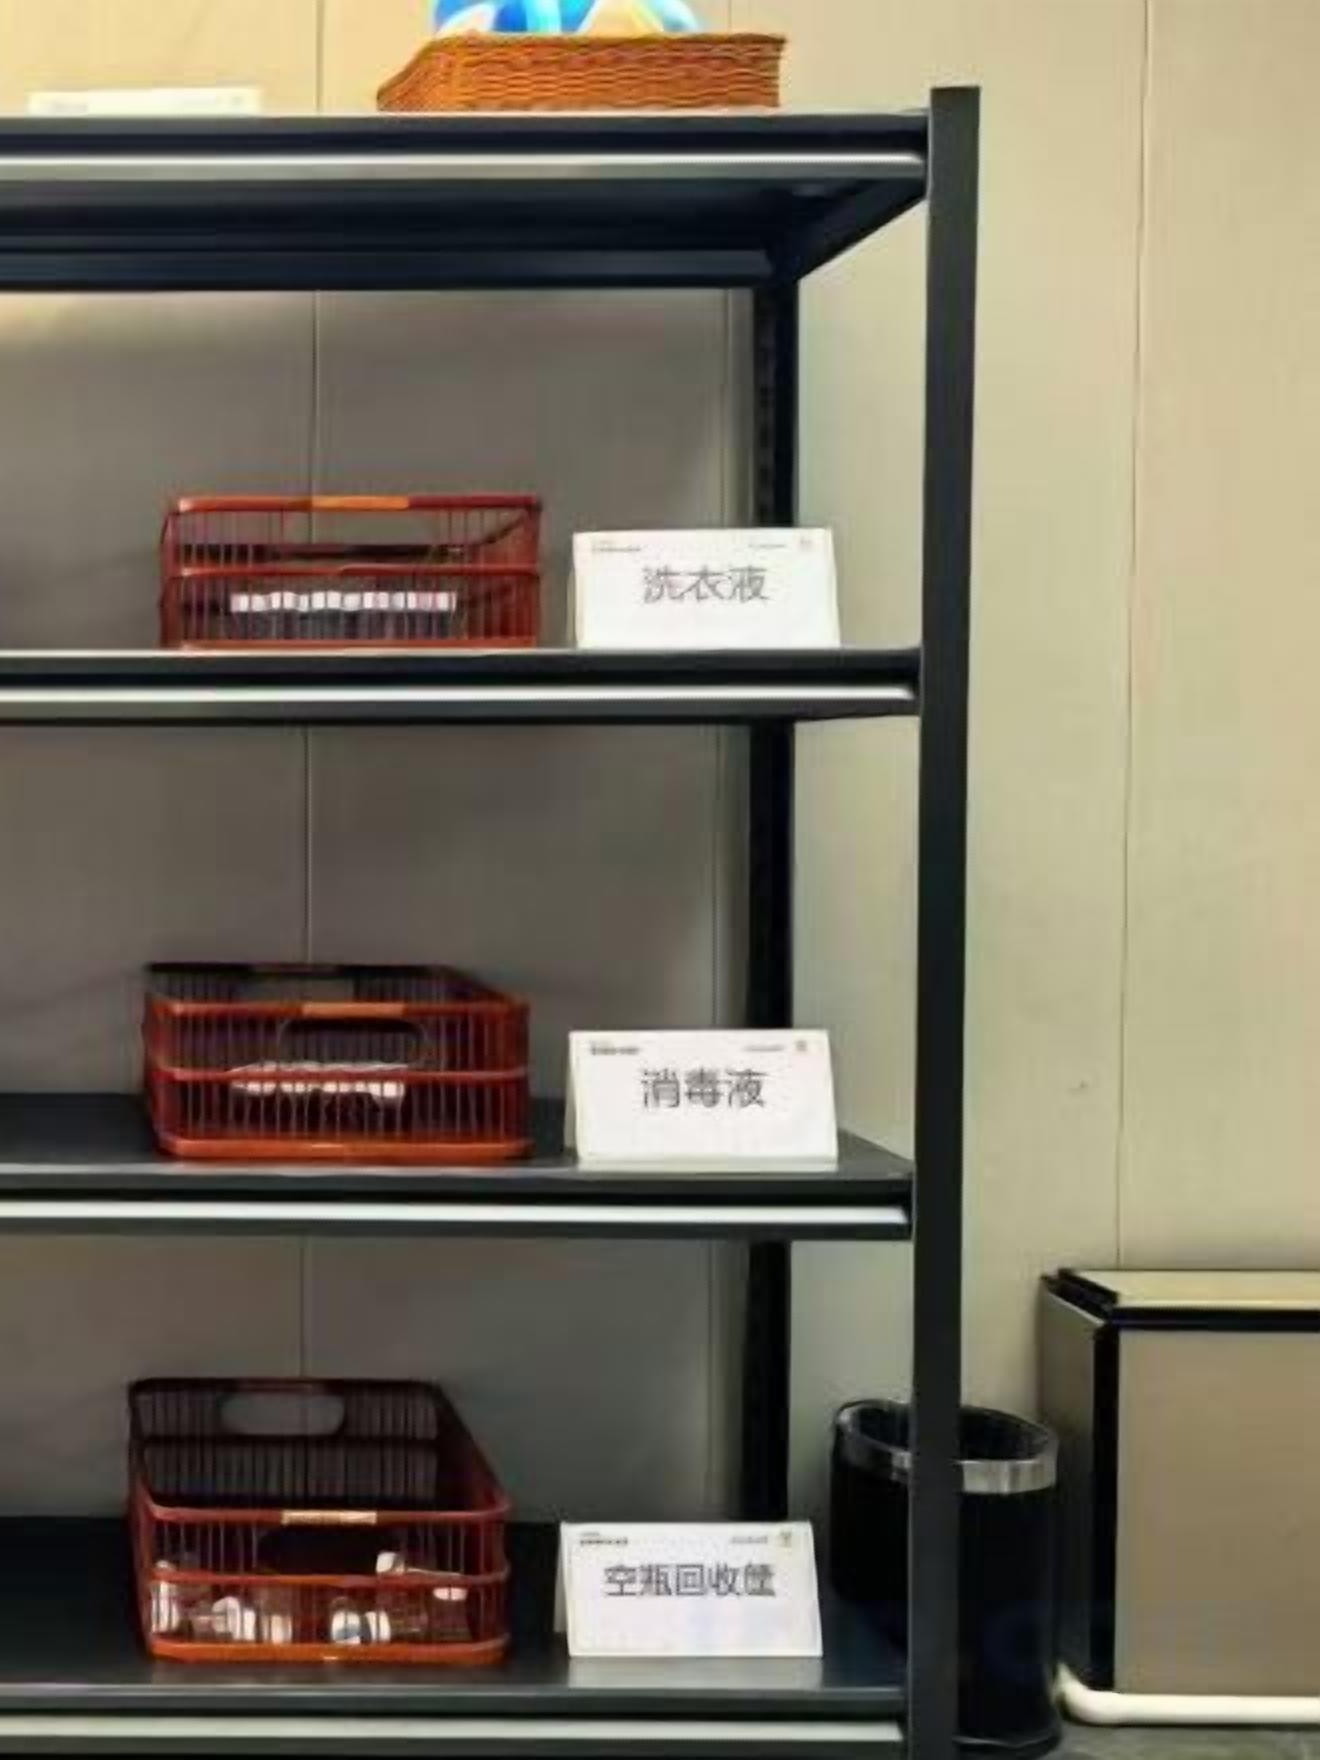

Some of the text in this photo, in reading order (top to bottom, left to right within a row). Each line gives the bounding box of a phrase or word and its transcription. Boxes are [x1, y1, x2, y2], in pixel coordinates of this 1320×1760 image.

[642, 565, 770, 604] 洗衣液
[641, 1067, 766, 1108] 消毒液
